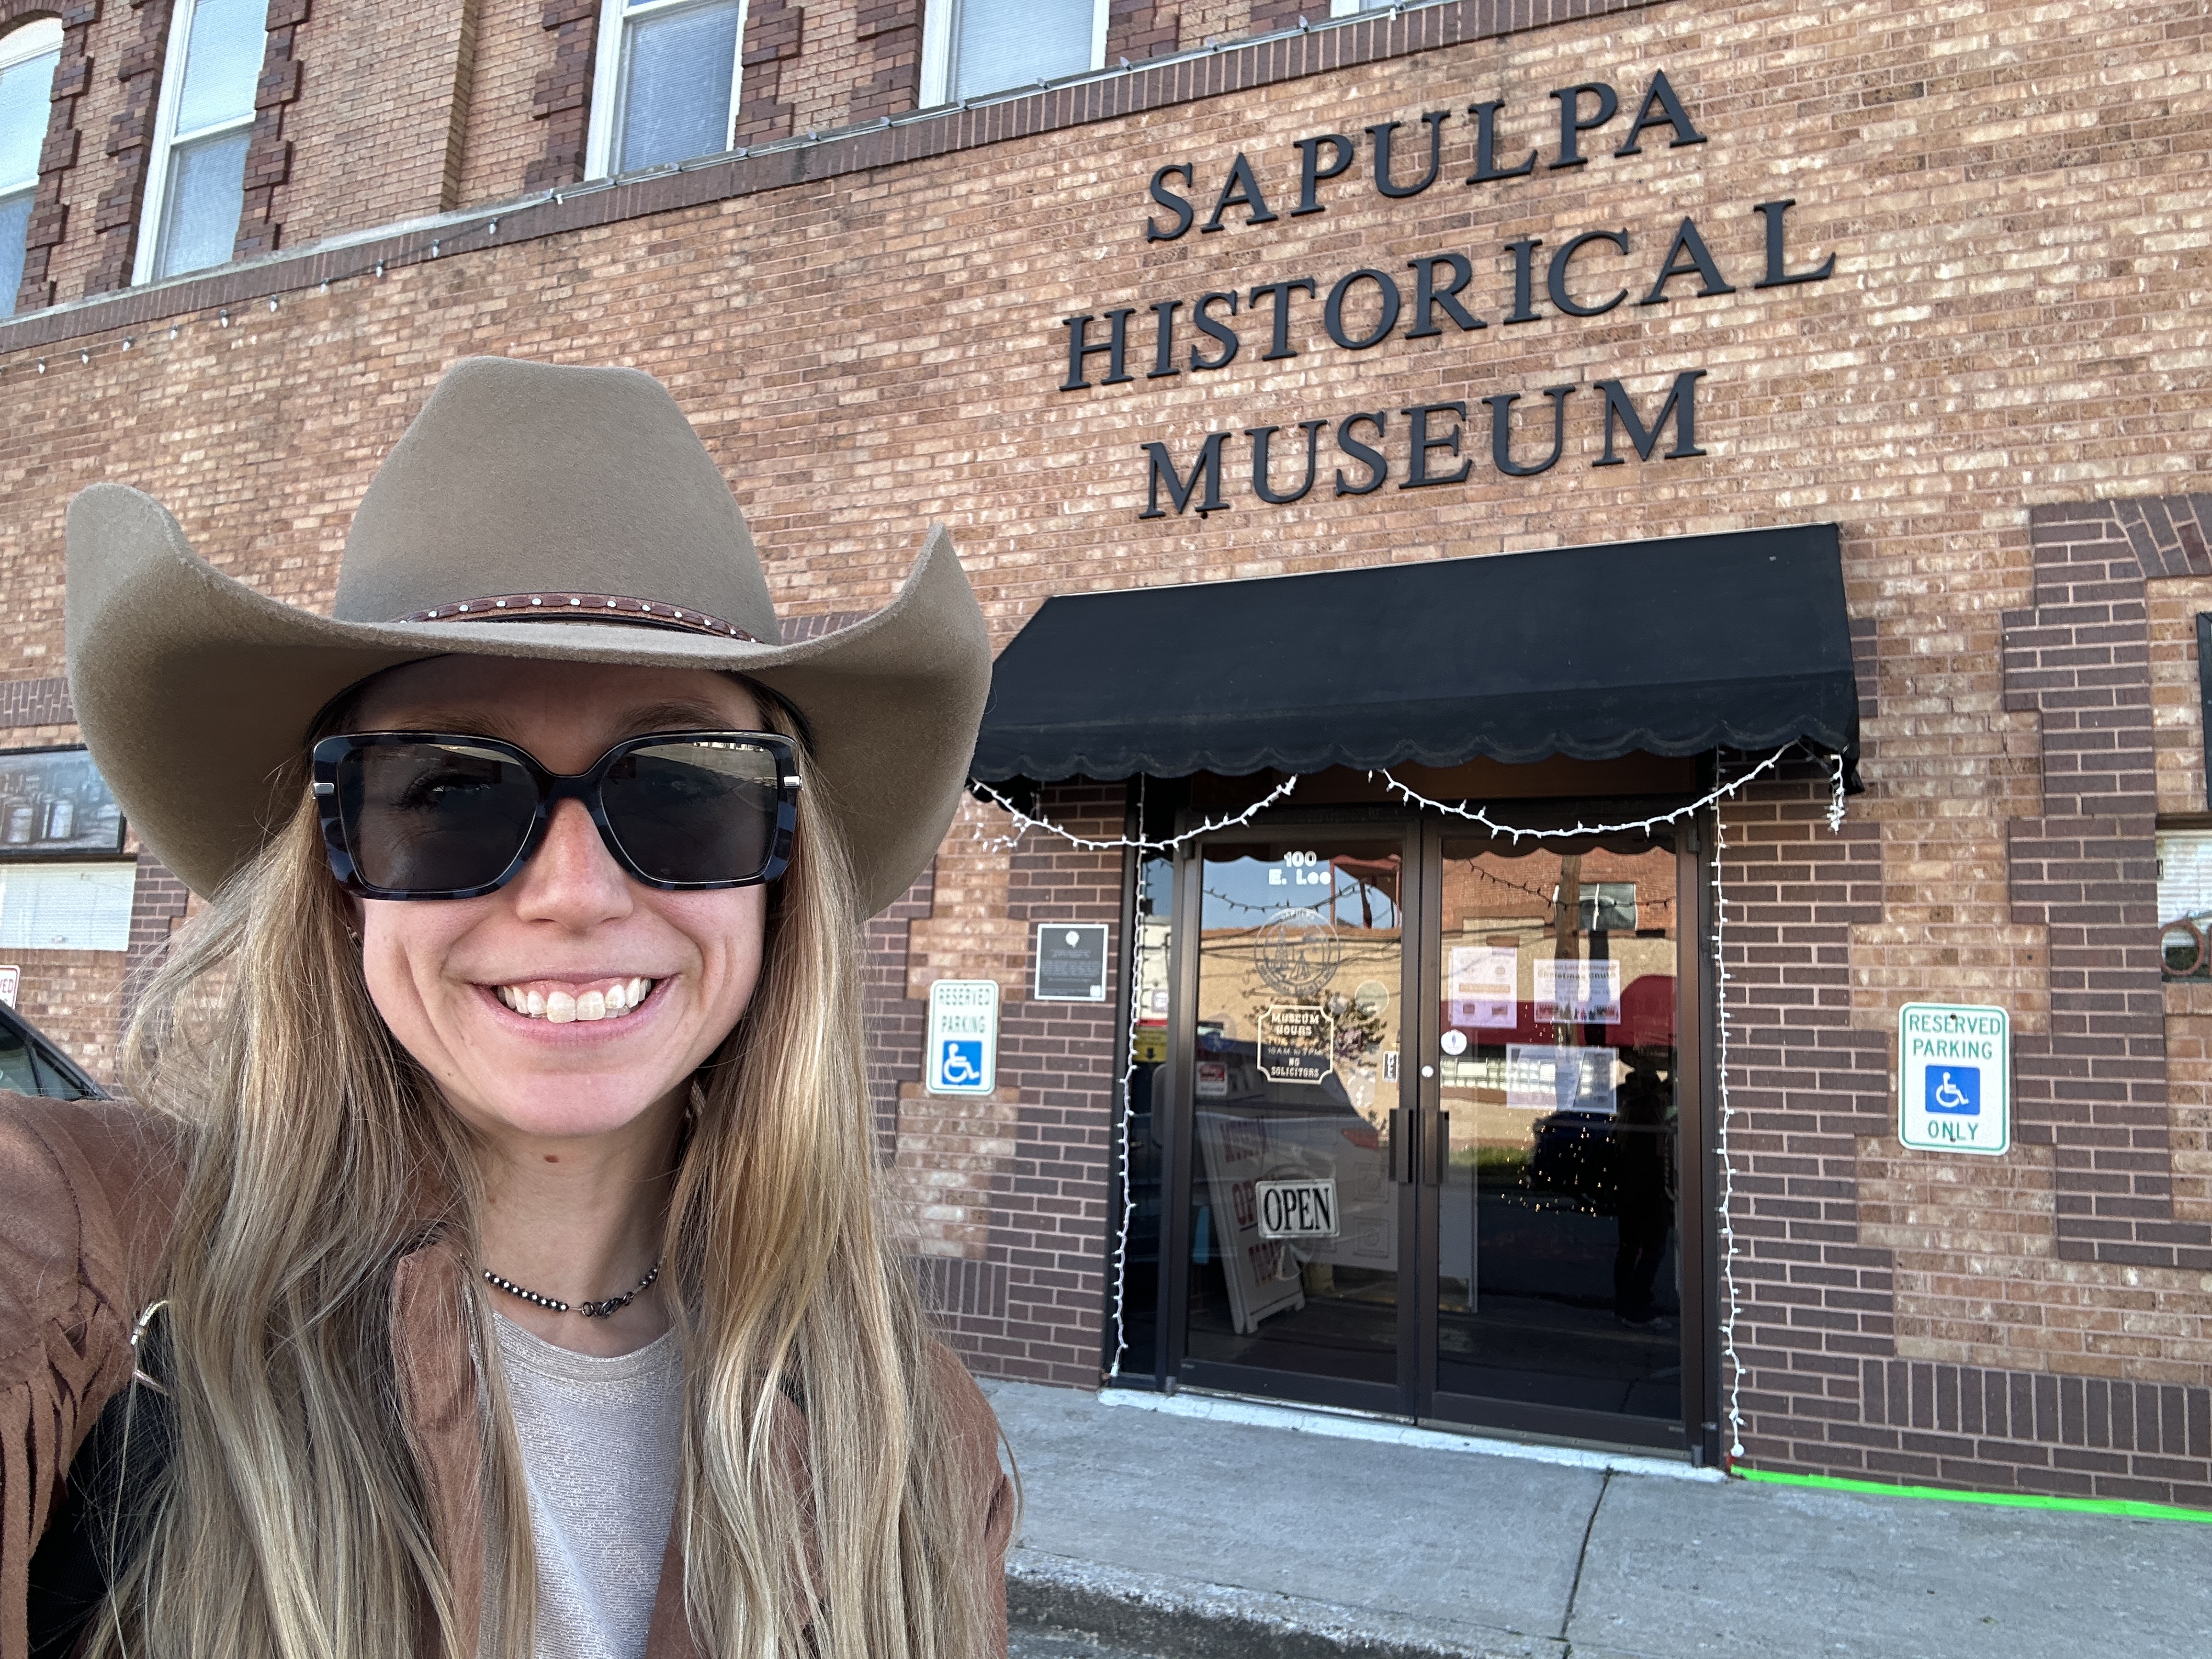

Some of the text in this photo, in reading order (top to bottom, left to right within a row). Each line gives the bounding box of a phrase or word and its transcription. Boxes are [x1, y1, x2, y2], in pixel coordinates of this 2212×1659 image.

[1147, 69, 1708, 242] SAPULPA
[1059, 199, 1836, 391] HISTORICAL
[1138, 369, 1707, 520] MUSEUM
[1284, 850, 1317, 867] 100
[1268, 868, 1287, 885] E.
[939, 988, 990, 1006] RESERVED
[941, 1015, 986, 1034] PARKING
[1271, 1013, 1319, 1024] MUSEUM
[1909, 1014, 2001, 1035] RESERVED
[1276, 1024, 1312, 1036] HOURS
[1913, 1038, 1993, 1059] PARKING
[1288, 1057, 1300, 1066] NO
[1271, 1066, 1319, 1077] SOLICITORS
[1928, 1120, 1978, 1141] ONLY
[1263, 1188, 1330, 1231] OPEN
